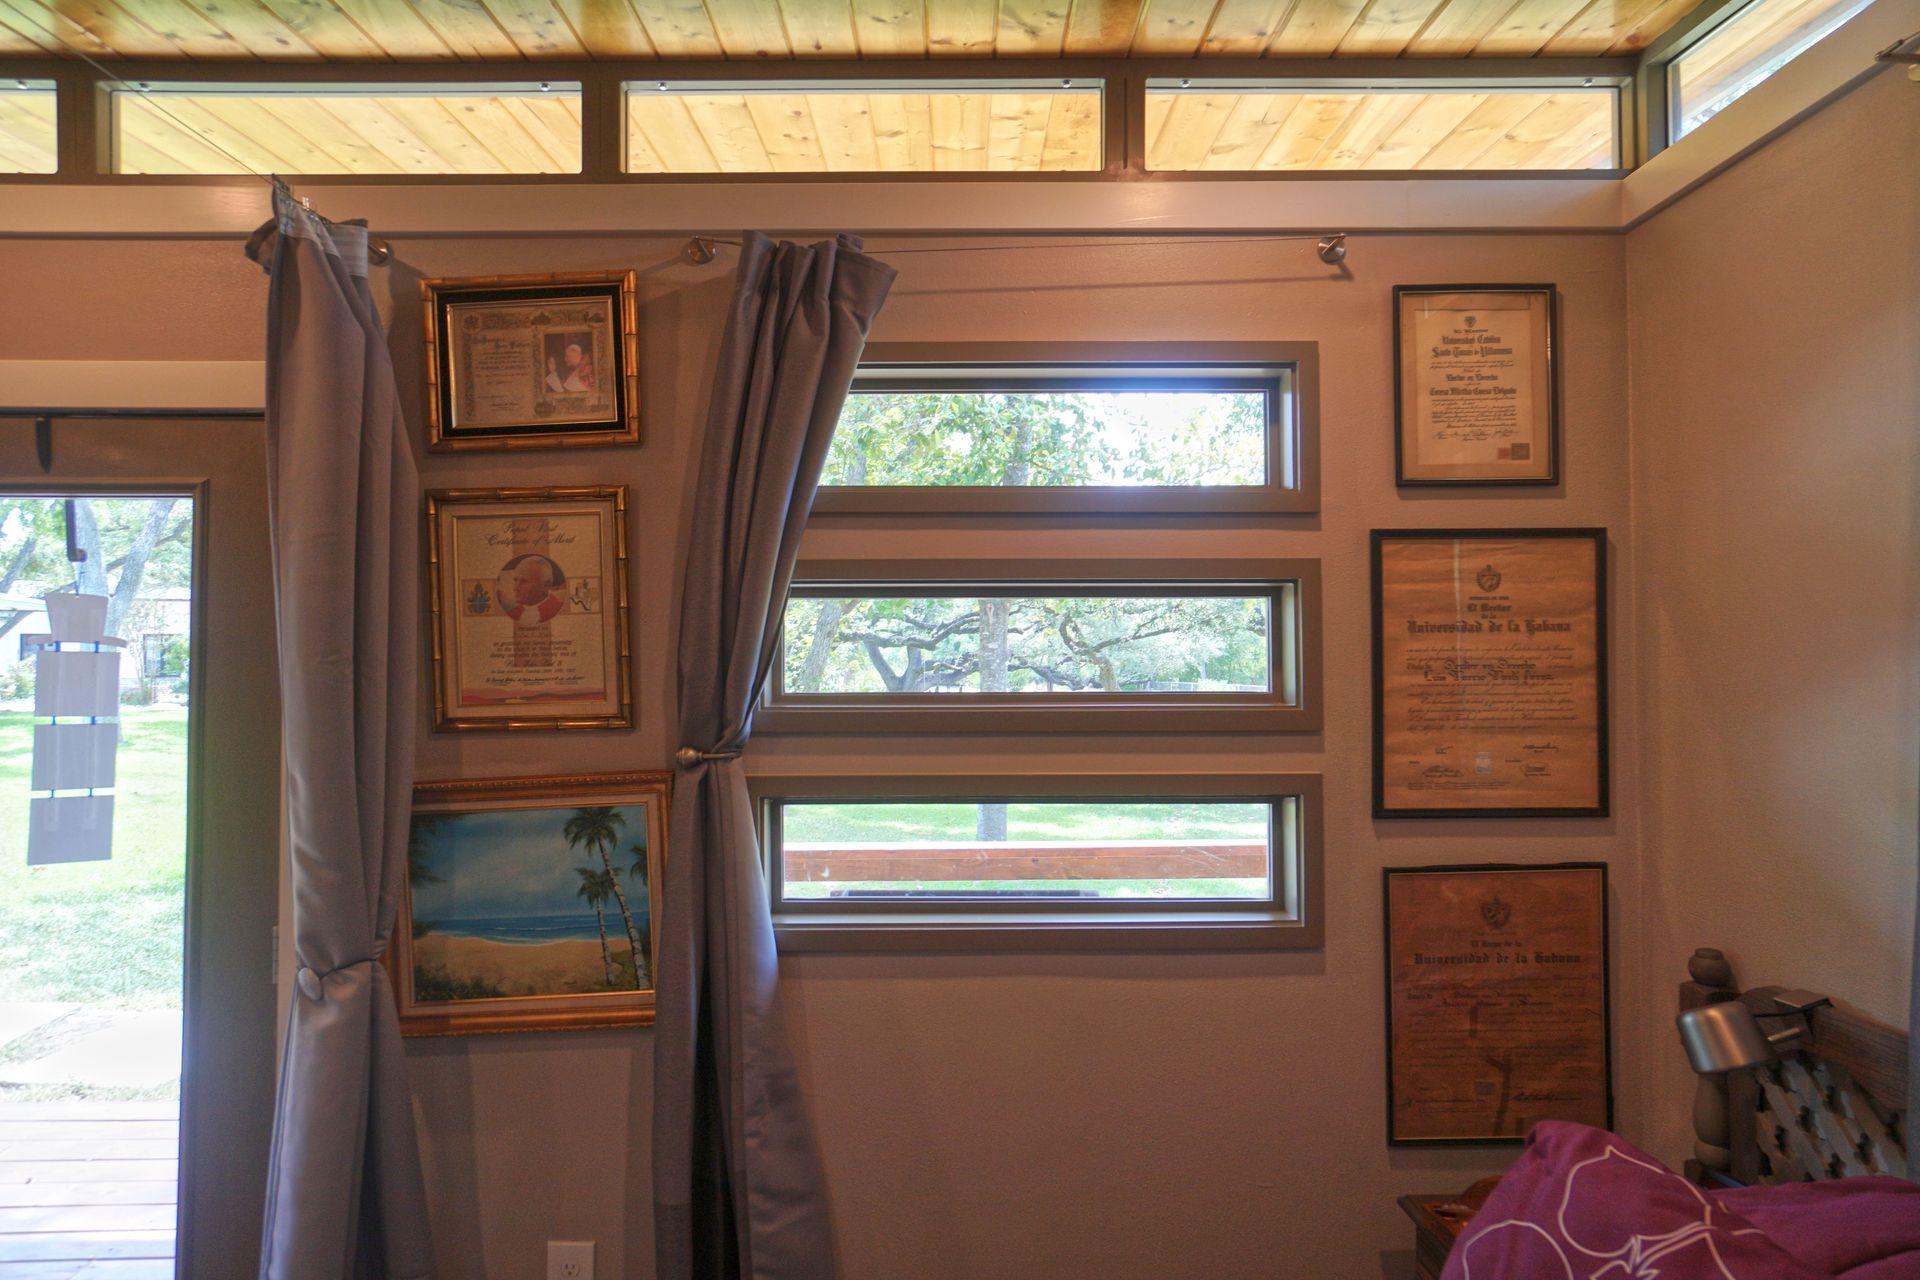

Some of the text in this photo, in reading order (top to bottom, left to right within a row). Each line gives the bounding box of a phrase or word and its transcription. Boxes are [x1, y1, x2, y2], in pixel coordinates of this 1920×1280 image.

[485, 533, 529, 546] Certificate
[1466, 602, 1513, 612] El Rector
[1406, 619, 1571, 636] Universidad de la Habana
[1413, 951, 1581, 965] Universidad de la Habana
